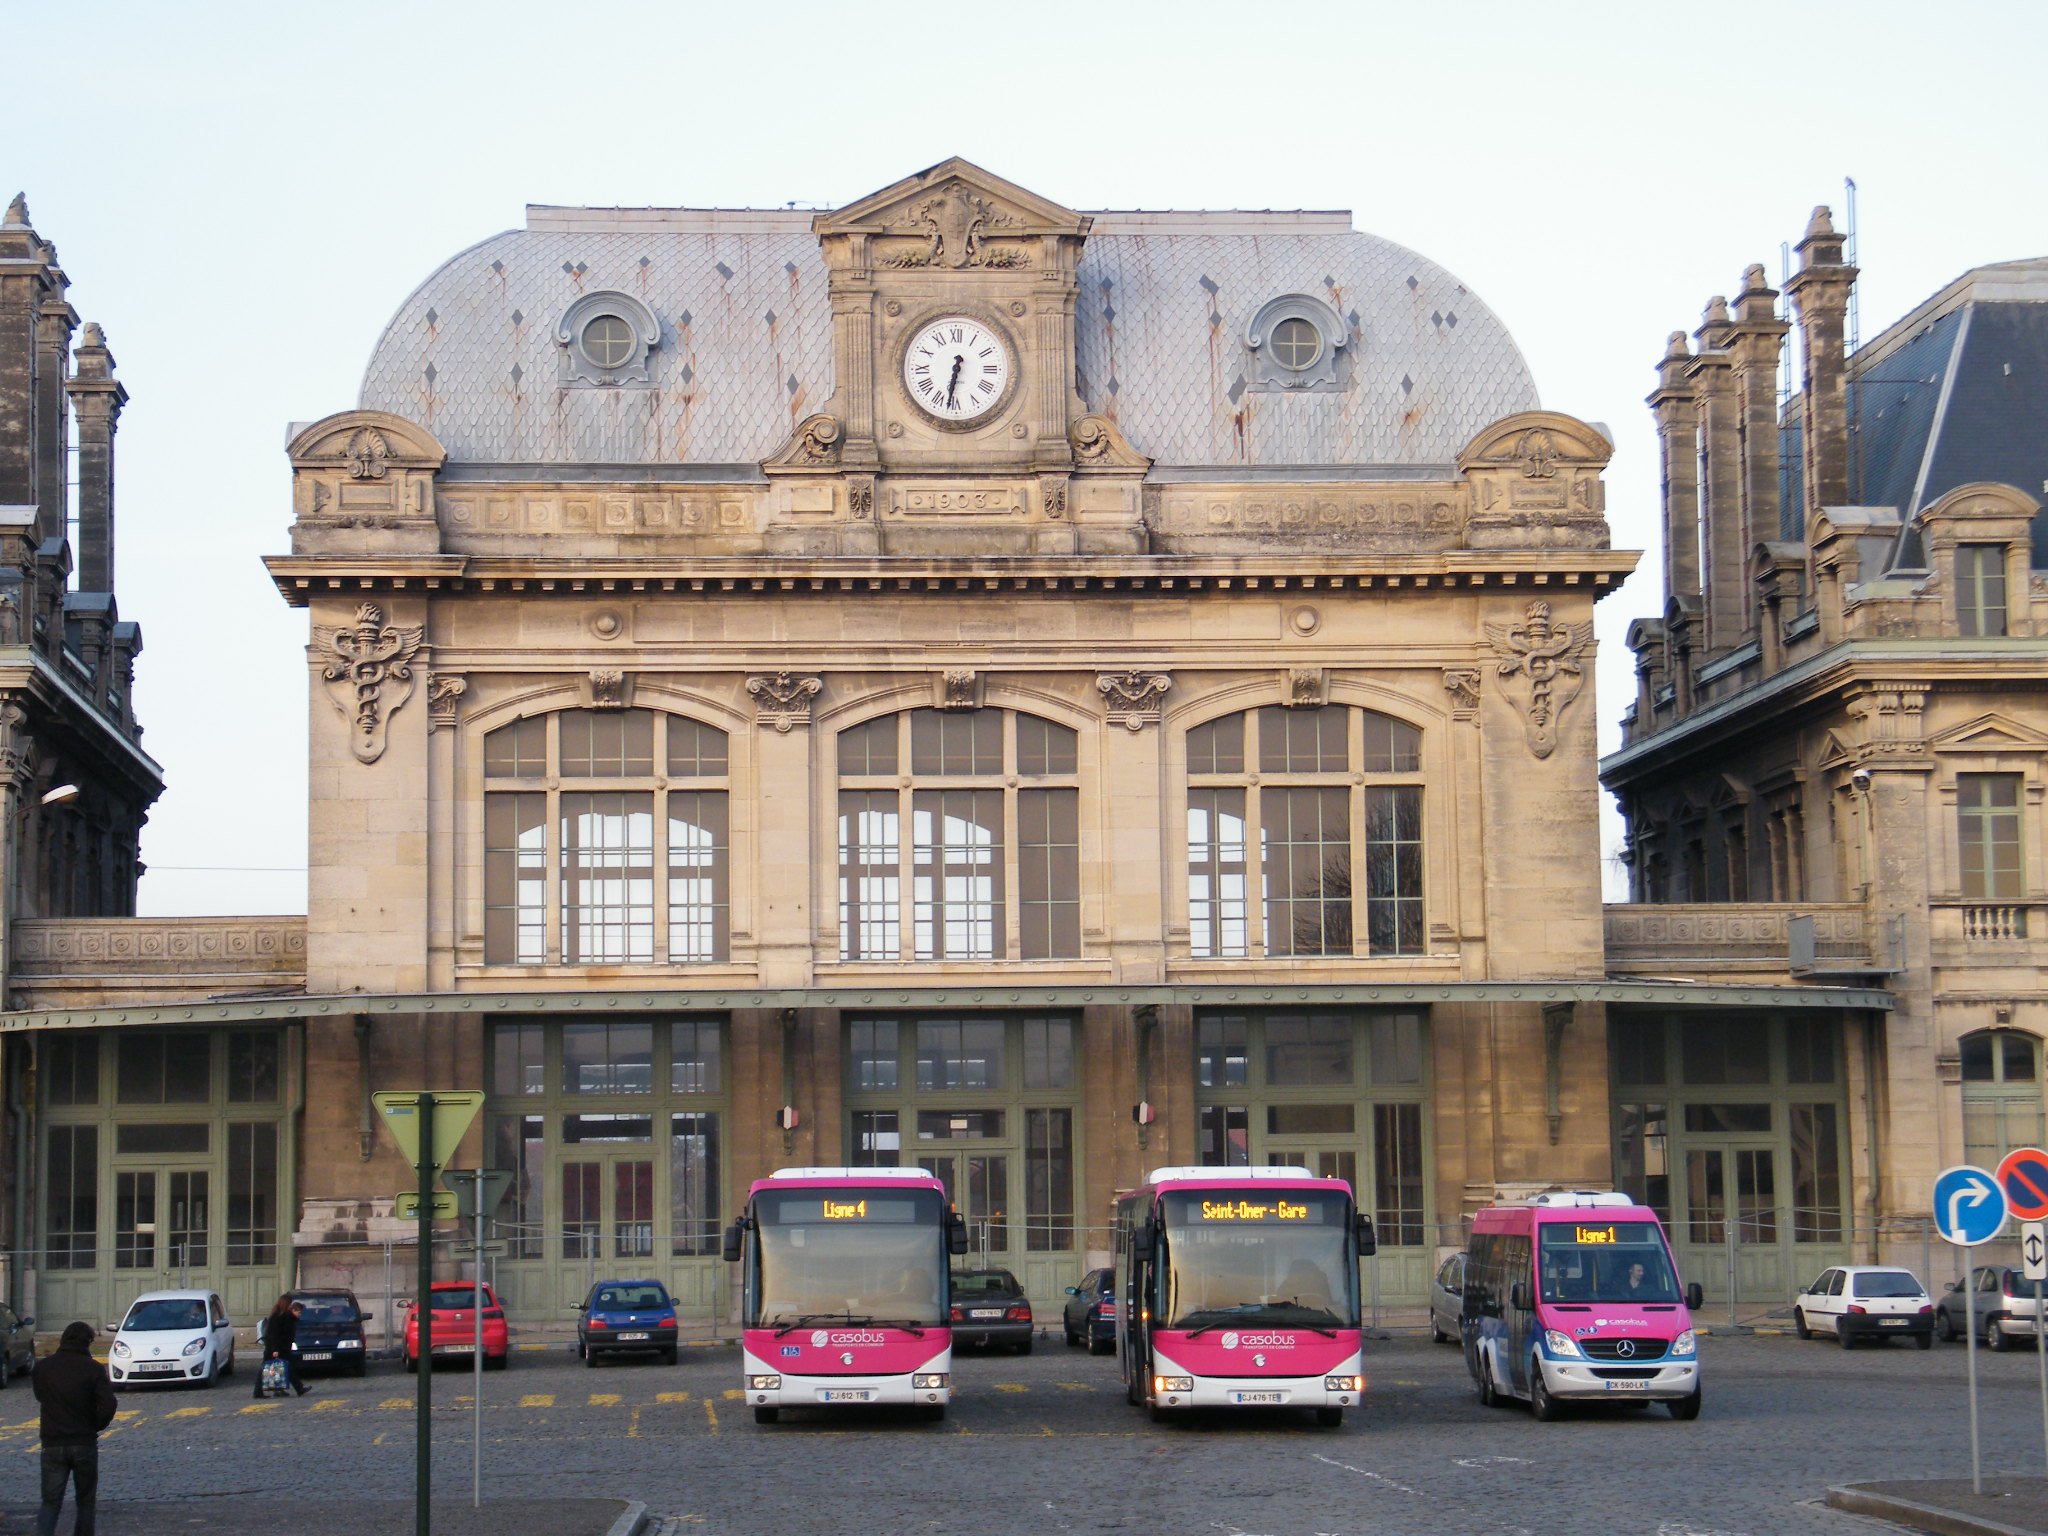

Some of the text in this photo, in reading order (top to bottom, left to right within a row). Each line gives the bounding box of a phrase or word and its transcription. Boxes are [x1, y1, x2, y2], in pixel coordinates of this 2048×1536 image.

[932, 332, 947, 348] XI
[950, 329, 963, 343] XII
[969, 334, 978, 347] I
[919, 346, 934, 358] X
[978, 347, 993, 358] II
[915, 364, 930, 374] IX
[983, 365, 998, 374] III
[918, 377, 934, 396] VIII
[931, 390, 945, 407] VII
[970, 393, 980, 407] V
[928, 493, 988, 509] 1903
[823, 1200, 866, 1218] Ligne 4
[1278, 1201, 1307, 1218] Gare
[1576, 1226, 1616, 1243] Ligne 1
[831, 1329, 885, 1343] casobus
[1241, 1330, 1296, 1345] casobus
